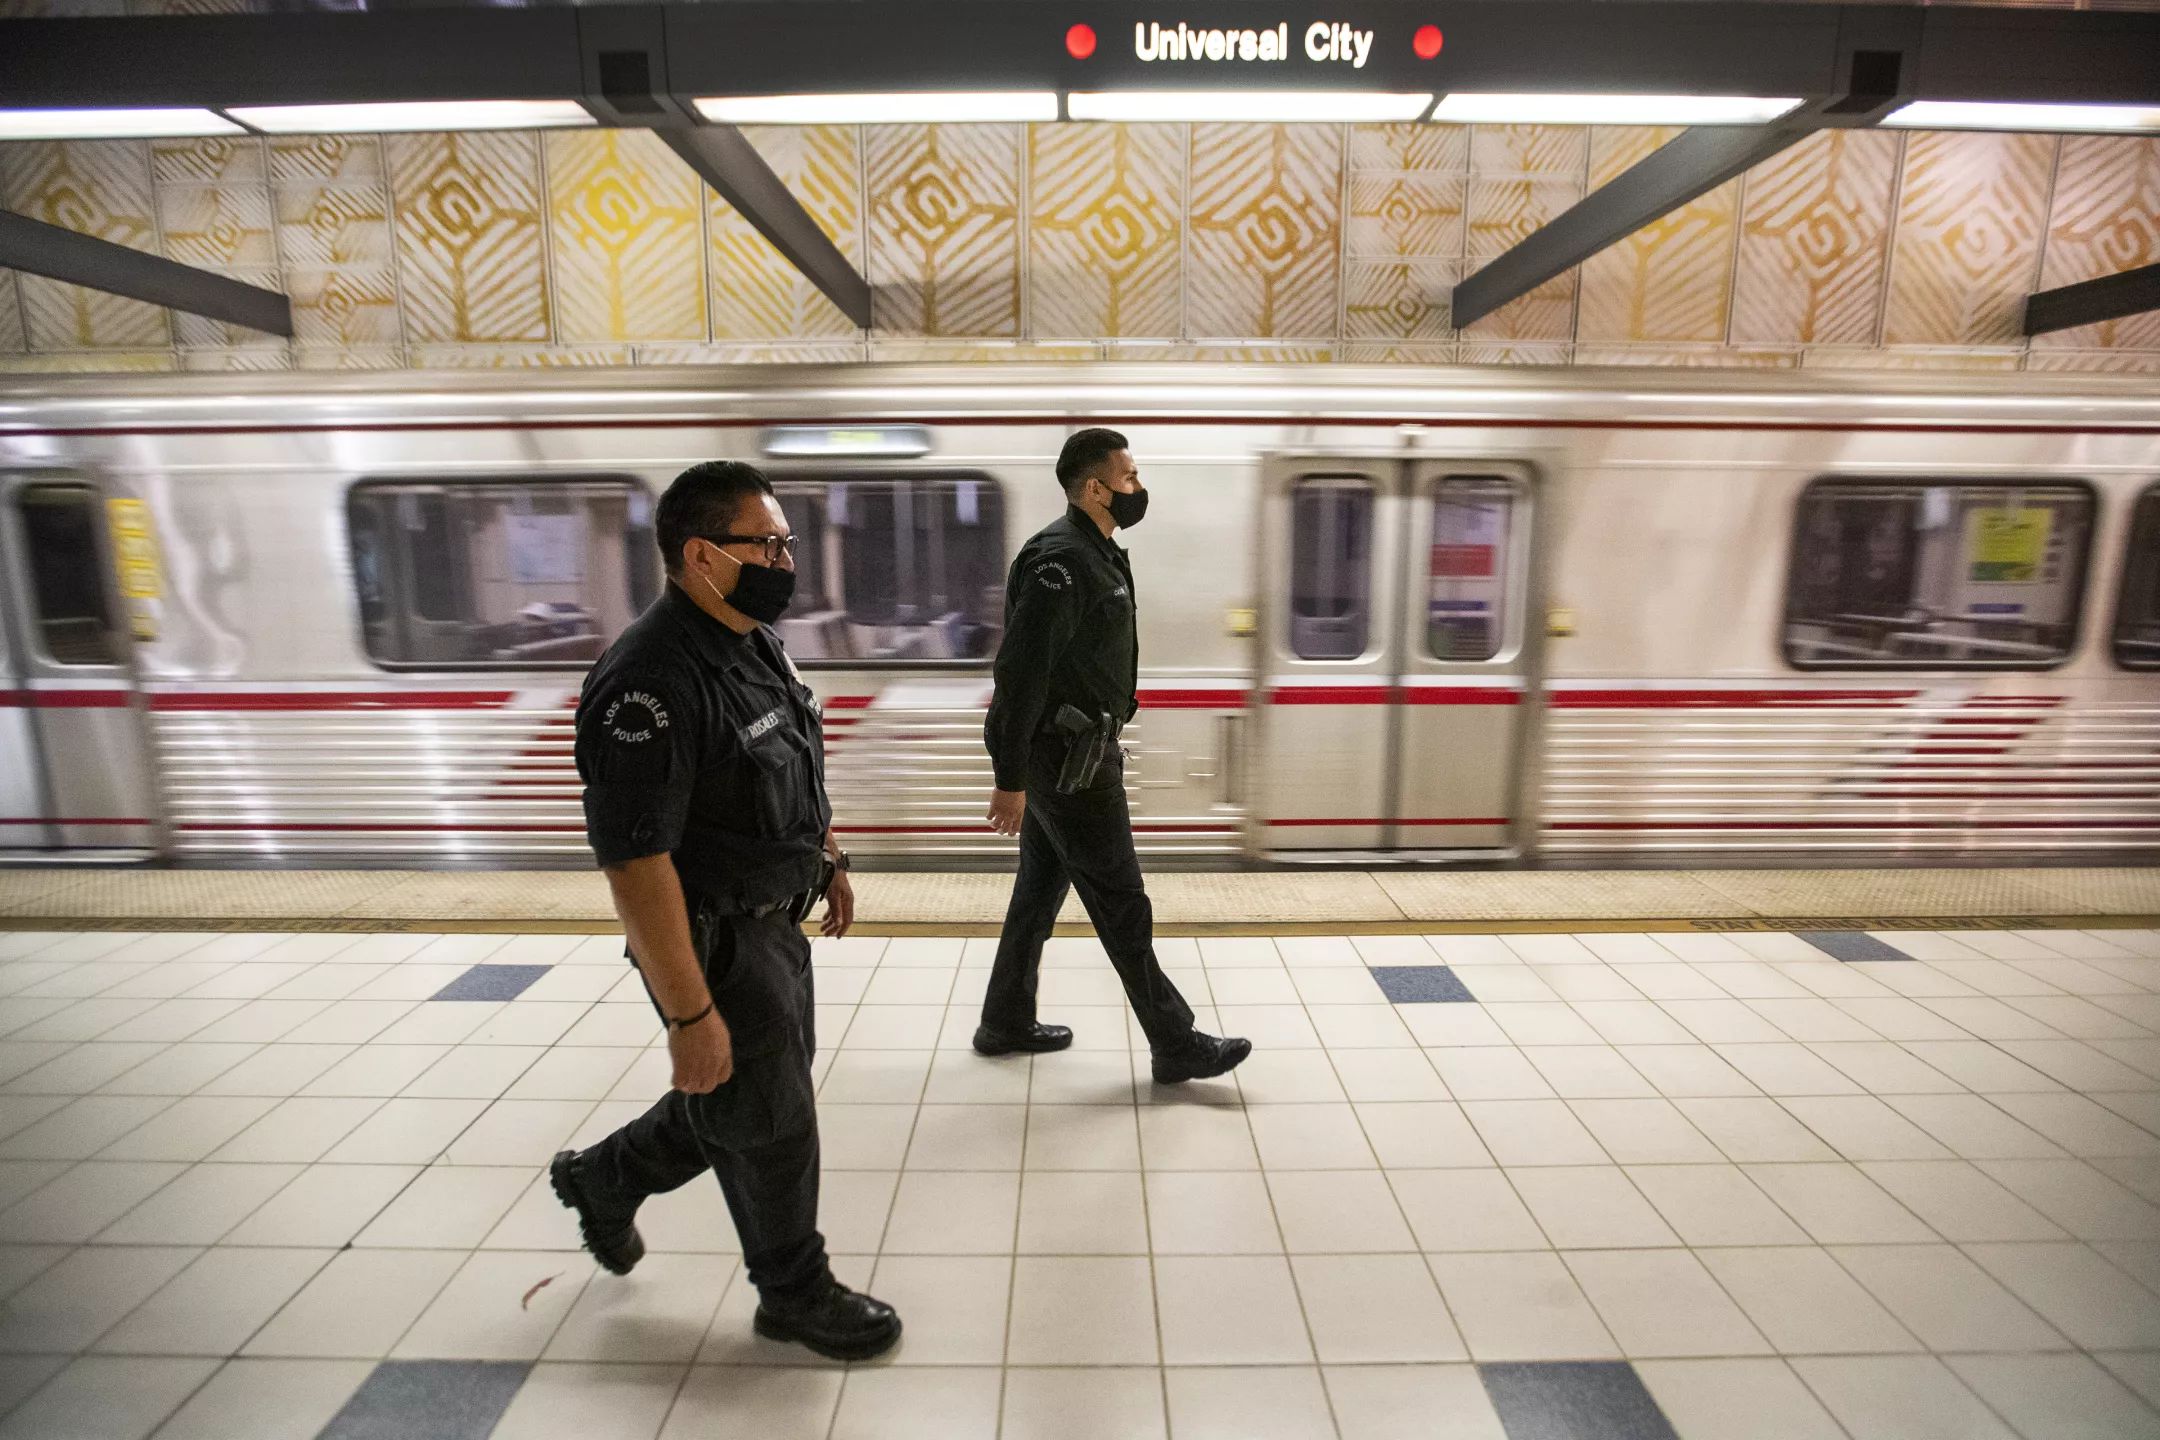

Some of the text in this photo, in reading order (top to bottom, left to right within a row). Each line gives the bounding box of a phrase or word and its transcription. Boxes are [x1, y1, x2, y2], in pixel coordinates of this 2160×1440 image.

[1135, 21, 1374, 68] Universal City
[1035, 562, 1072, 585] LOS ANGELES
[1039, 577, 1061, 588] POLICE
[603, 691, 669, 729] LOS ANGELES
[612, 727, 652, 742] POLICE
[748, 712, 779, 738] ROSALES
[1690, 920, 1757, 930] STAY
[1761, 919, 1867, 929] BEHIND
